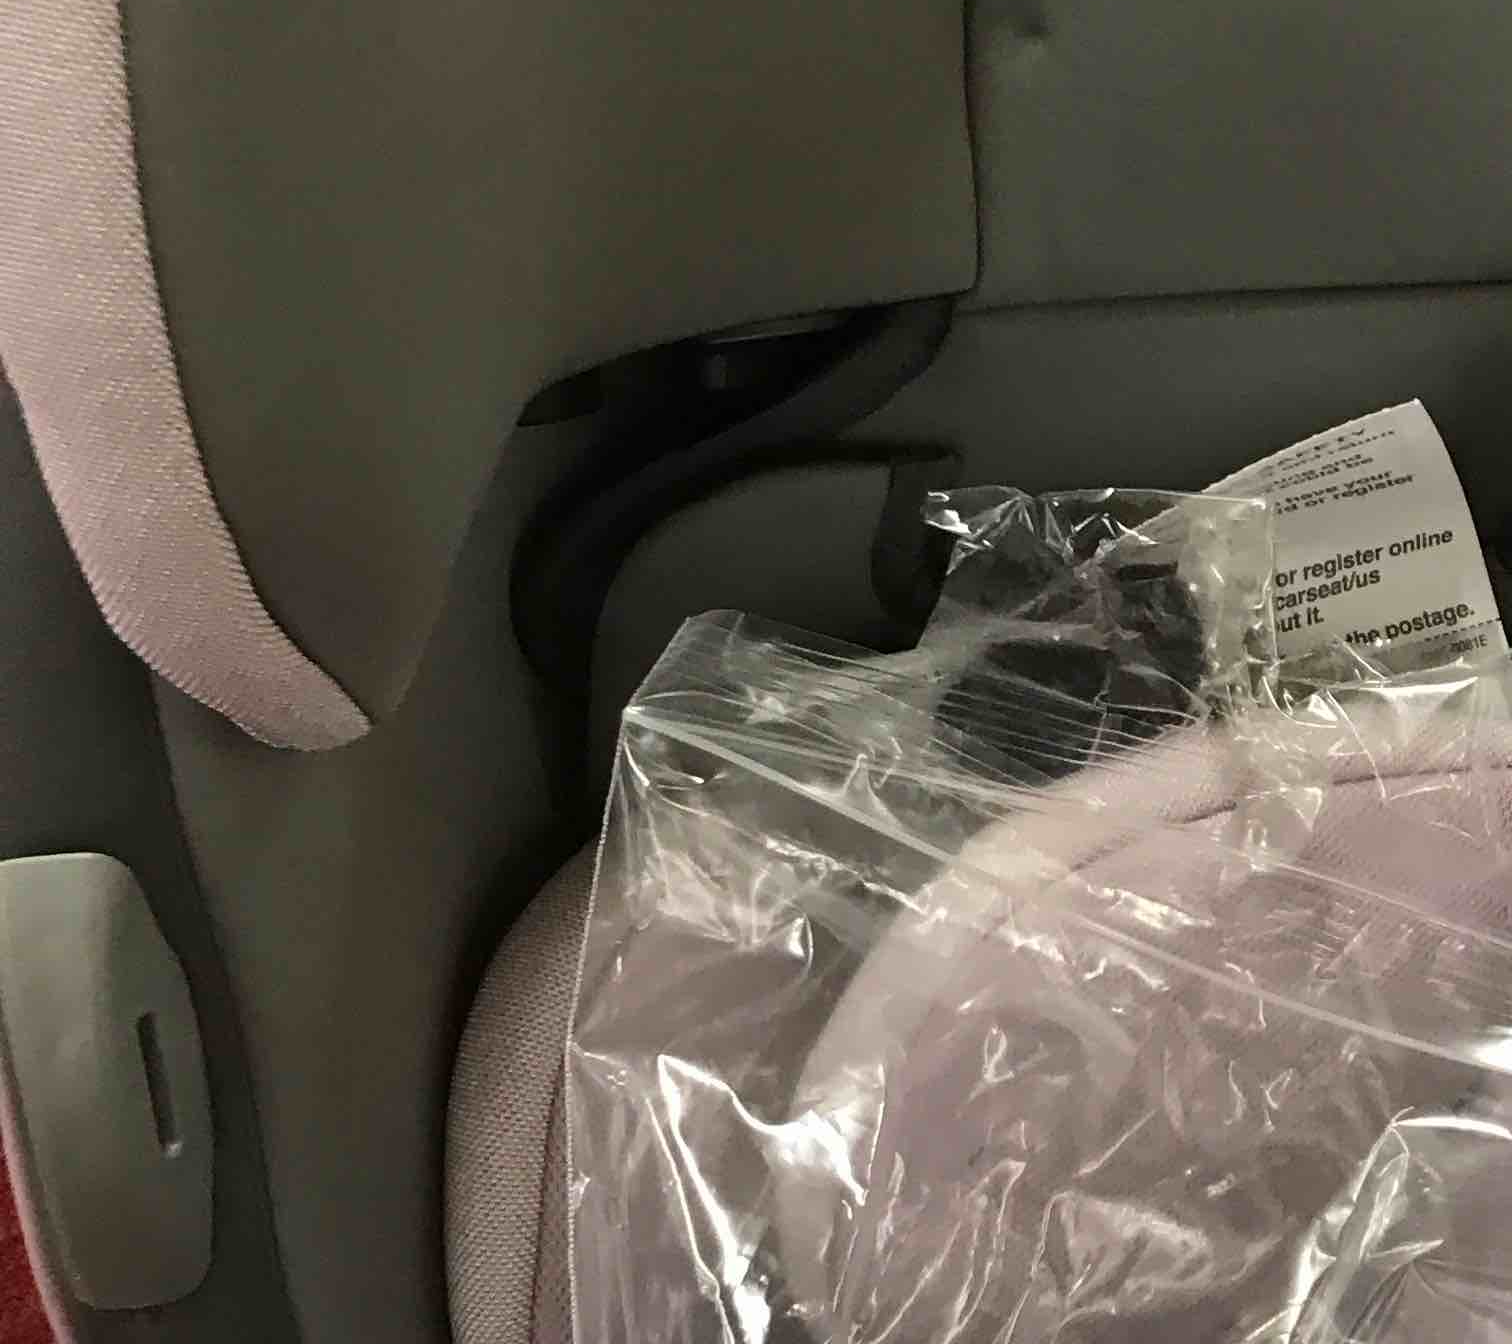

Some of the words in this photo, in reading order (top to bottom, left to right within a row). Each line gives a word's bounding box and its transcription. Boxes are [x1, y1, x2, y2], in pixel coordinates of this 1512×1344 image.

[1284, 484, 1339, 505] have
[1343, 470, 1394, 490] your
[1303, 493, 1327, 509] or
[1332, 472, 1415, 501] register
[1274, 569, 1298, 588] or
[1303, 546, 1385, 579] register
[1388, 529, 1454, 557] online
[1306, 606, 1325, 626] it.
[1385, 602, 1476, 641] postage.
